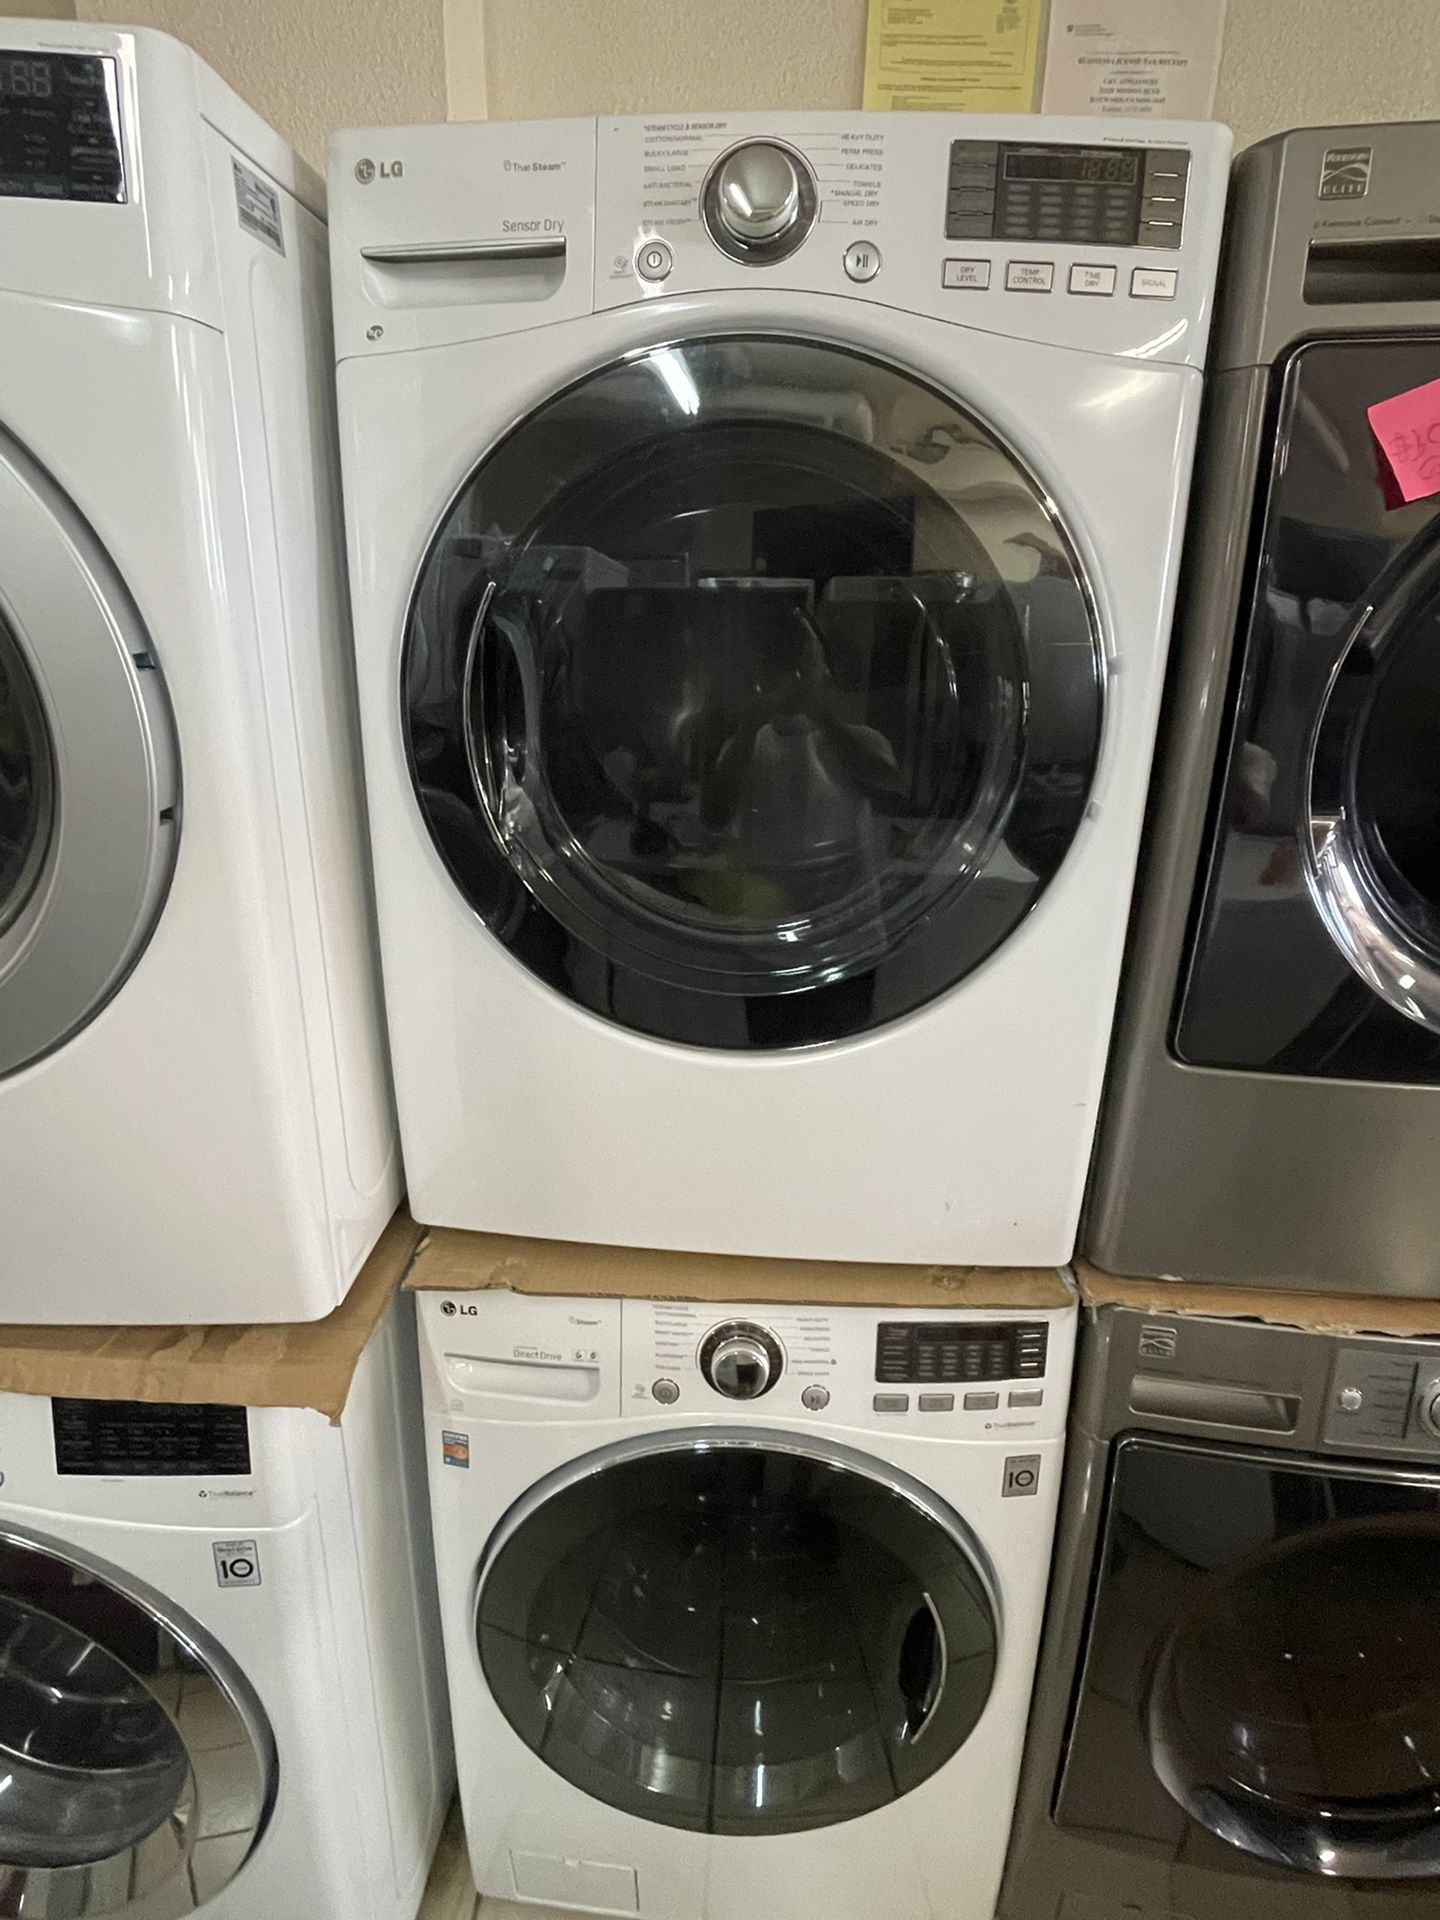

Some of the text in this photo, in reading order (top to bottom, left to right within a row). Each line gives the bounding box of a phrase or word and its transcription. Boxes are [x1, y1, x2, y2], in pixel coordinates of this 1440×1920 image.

[380, 160, 404, 178] LG
[667, 164, 686, 172] LOAD
[846, 163, 882, 171] DELICATES
[1322, 183, 1365, 194] ELITE
[502, 218, 565, 234] Sensor Dry
[1020, 268, 1040, 276] TEMP
[1084, 271, 1101, 279] TIME
[956, 273, 977, 282] LEVEL
[1012, 276, 1046, 285] CONTROL
[1084, 279, 1100, 288] DRY
[1141, 278, 1168, 288] SIGNAL
[460, 1304, 478, 1316] LG
[513, 1350, 562, 1362] Direct Drive
[220, 1558, 254, 1579] 10
